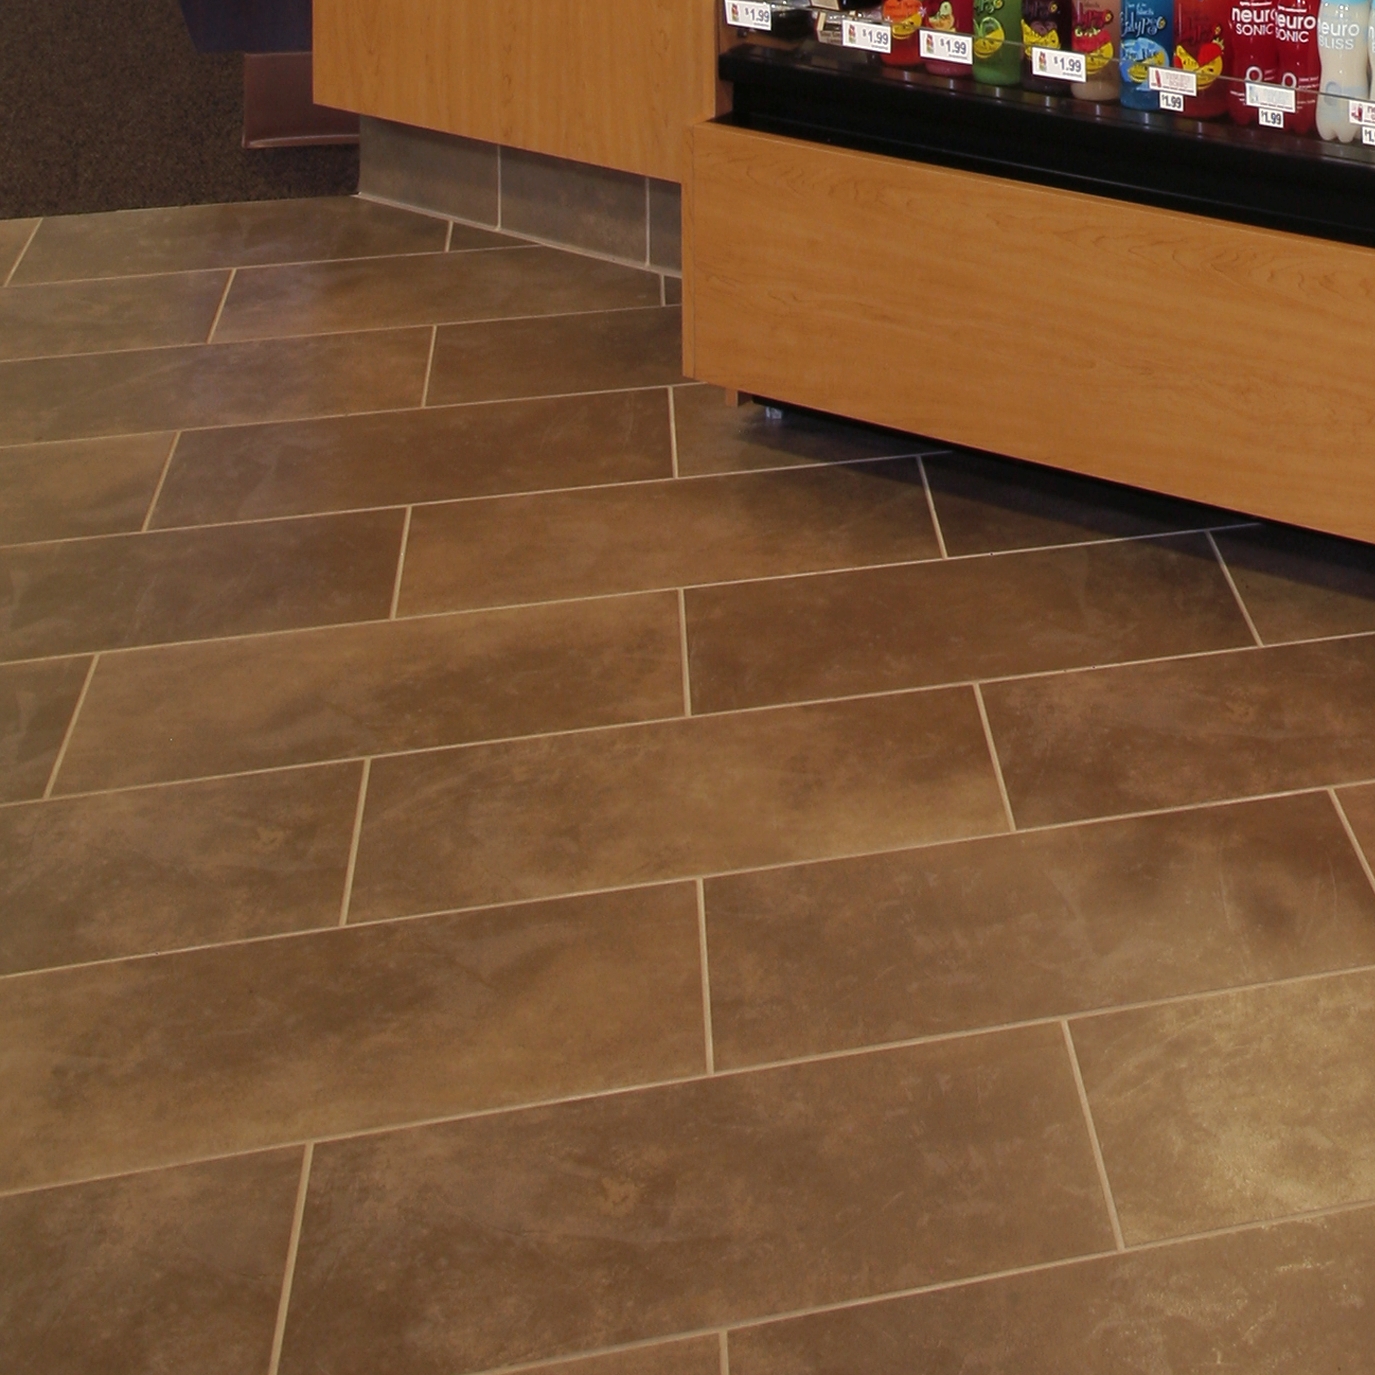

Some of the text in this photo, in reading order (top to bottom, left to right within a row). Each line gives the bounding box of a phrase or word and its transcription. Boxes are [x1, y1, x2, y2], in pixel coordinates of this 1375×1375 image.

[745, 6, 770, 24] $1.99
[862, 28, 889, 45] $1.99
[1235, 23, 1275, 36] SONIC
[940, 38, 967, 55] $1.99
[1054, 56, 1082, 73] $1.99
